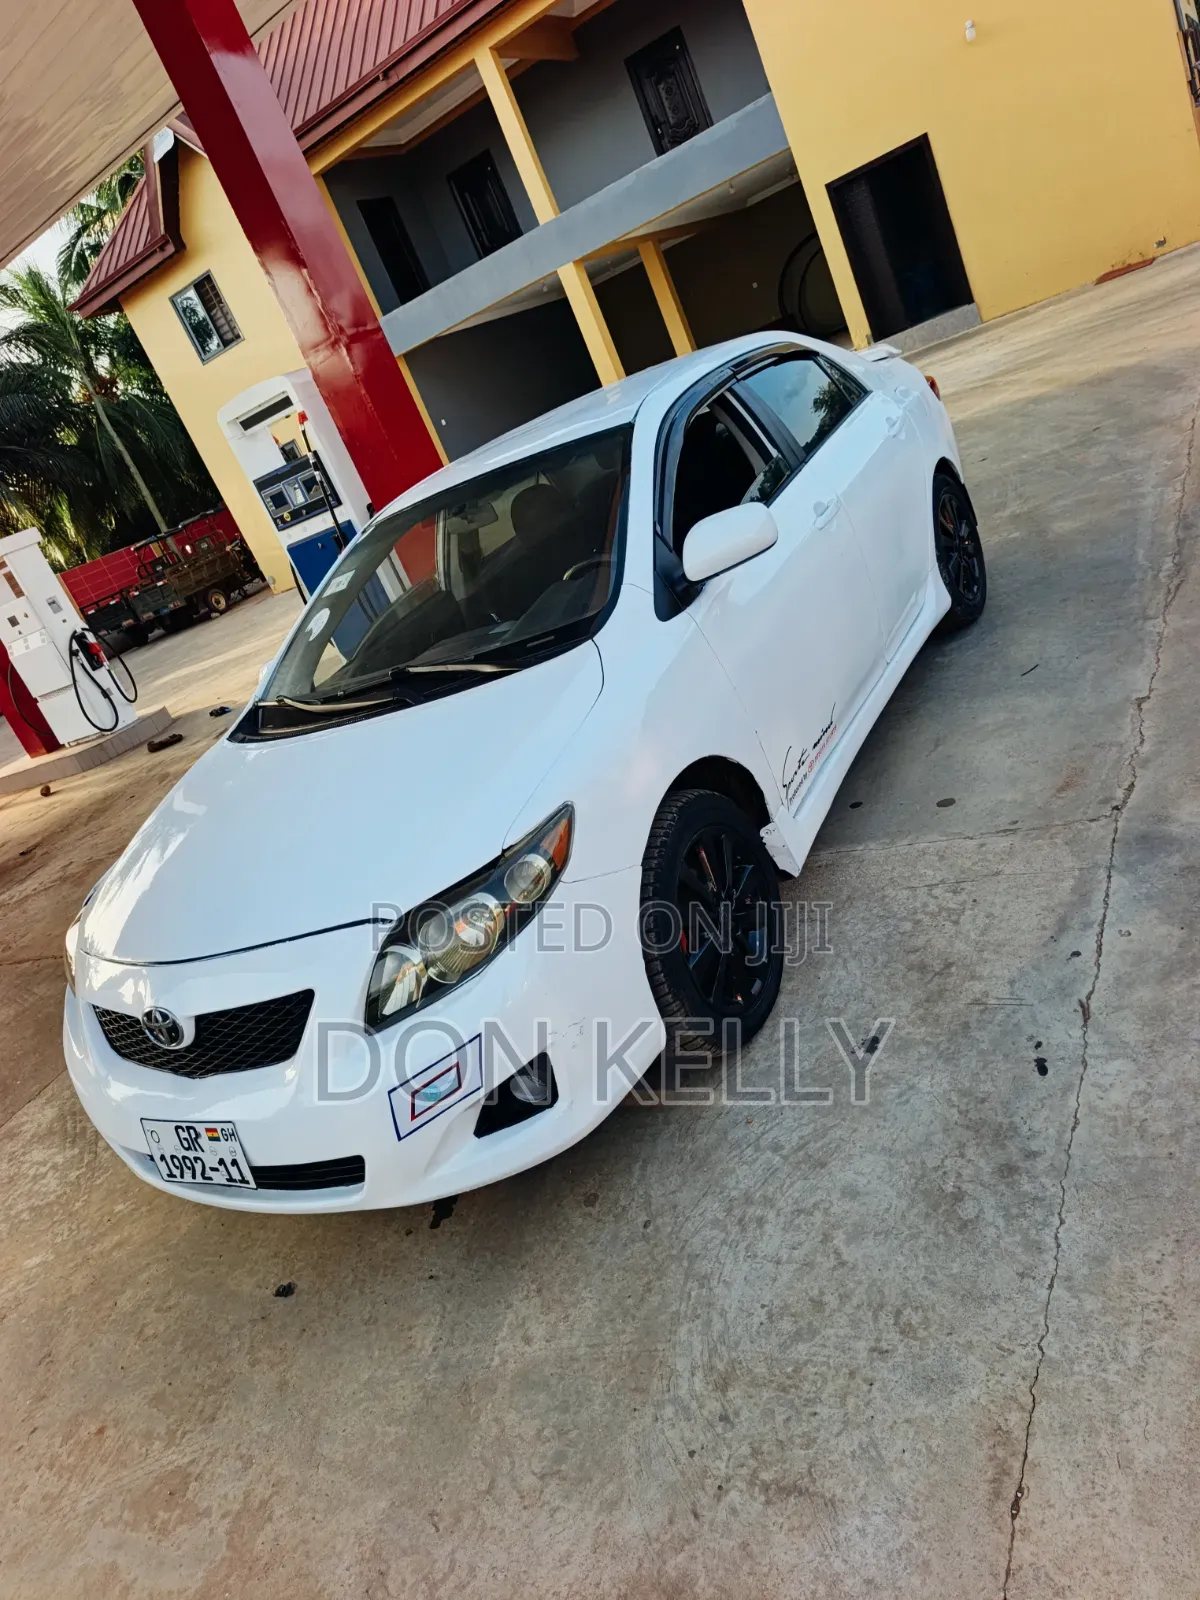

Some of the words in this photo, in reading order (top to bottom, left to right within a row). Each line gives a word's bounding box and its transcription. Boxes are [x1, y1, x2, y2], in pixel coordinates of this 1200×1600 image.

[174, 1125, 205, 1153] GR
[220, 1127, 238, 1143] GH
[159, 1153, 251, 1185] 1992-11
